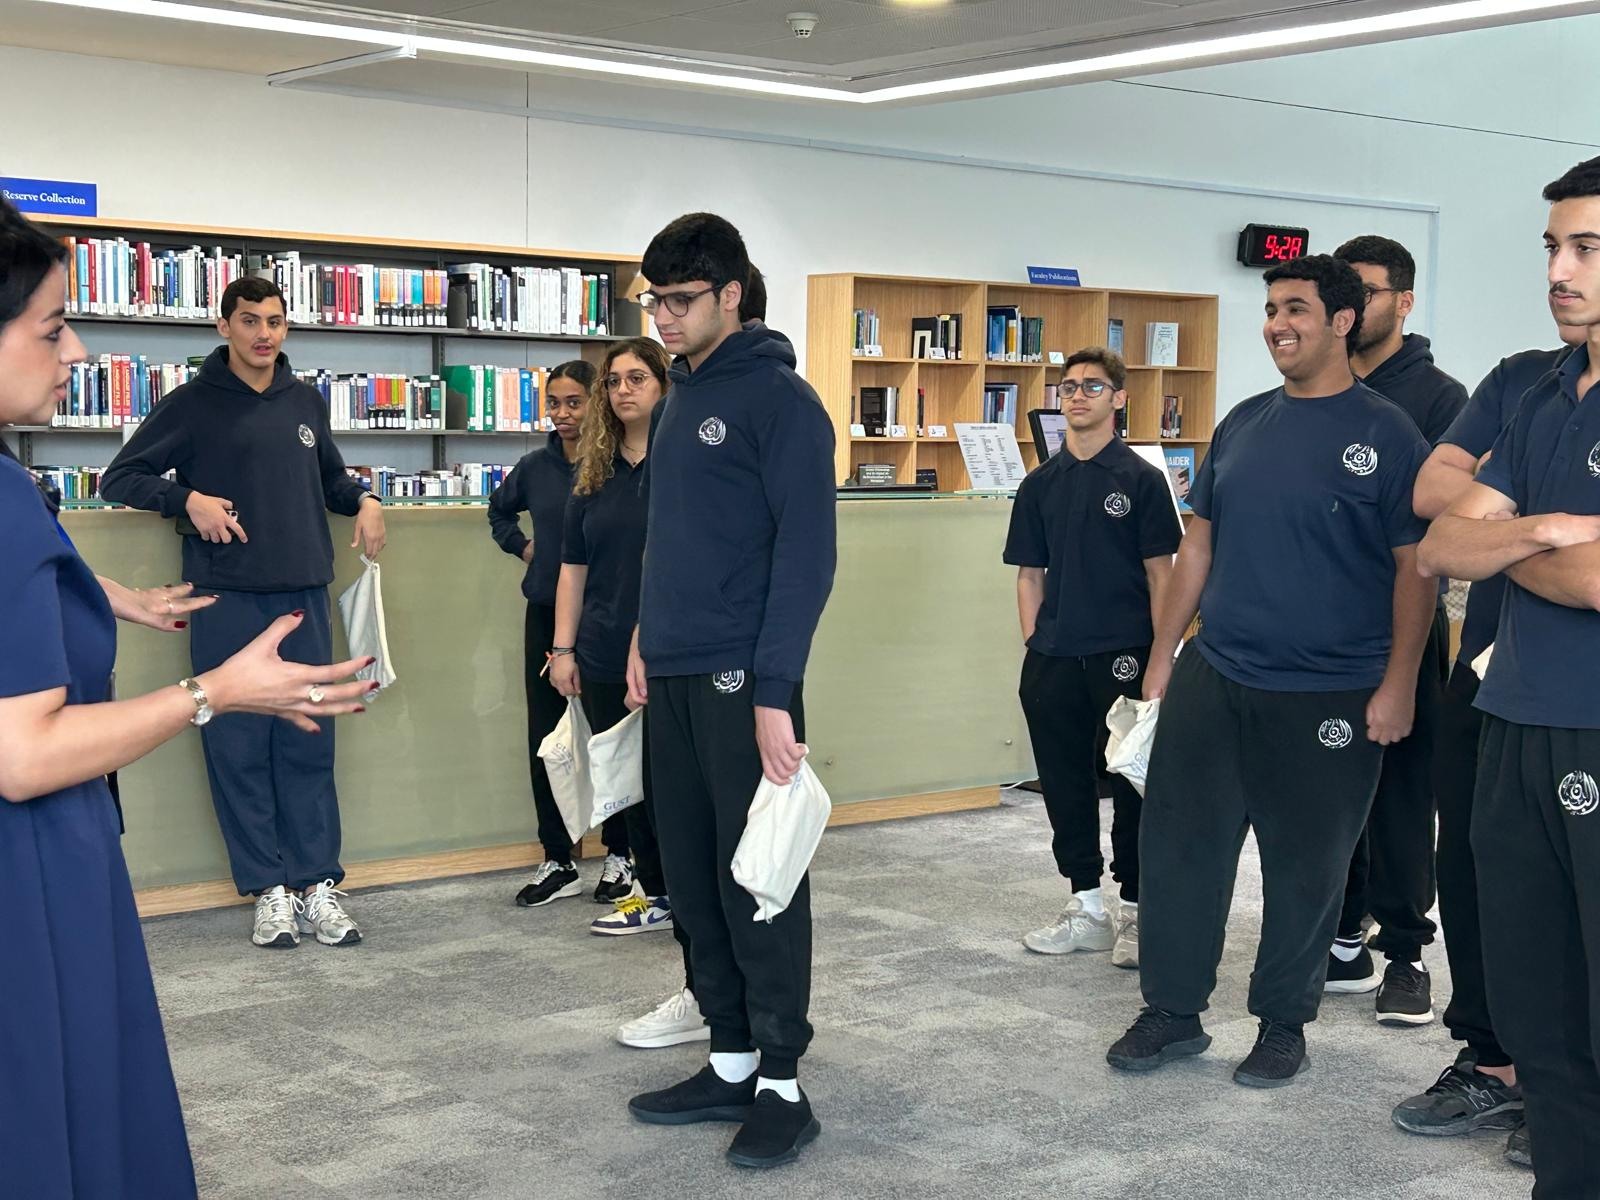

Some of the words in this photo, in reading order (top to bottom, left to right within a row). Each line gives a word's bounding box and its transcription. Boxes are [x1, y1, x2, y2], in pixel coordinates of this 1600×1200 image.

[3, 189, 38, 202] Reserve
[40, 192, 86, 205] Collection
[603, 794, 631, 811] GUST
